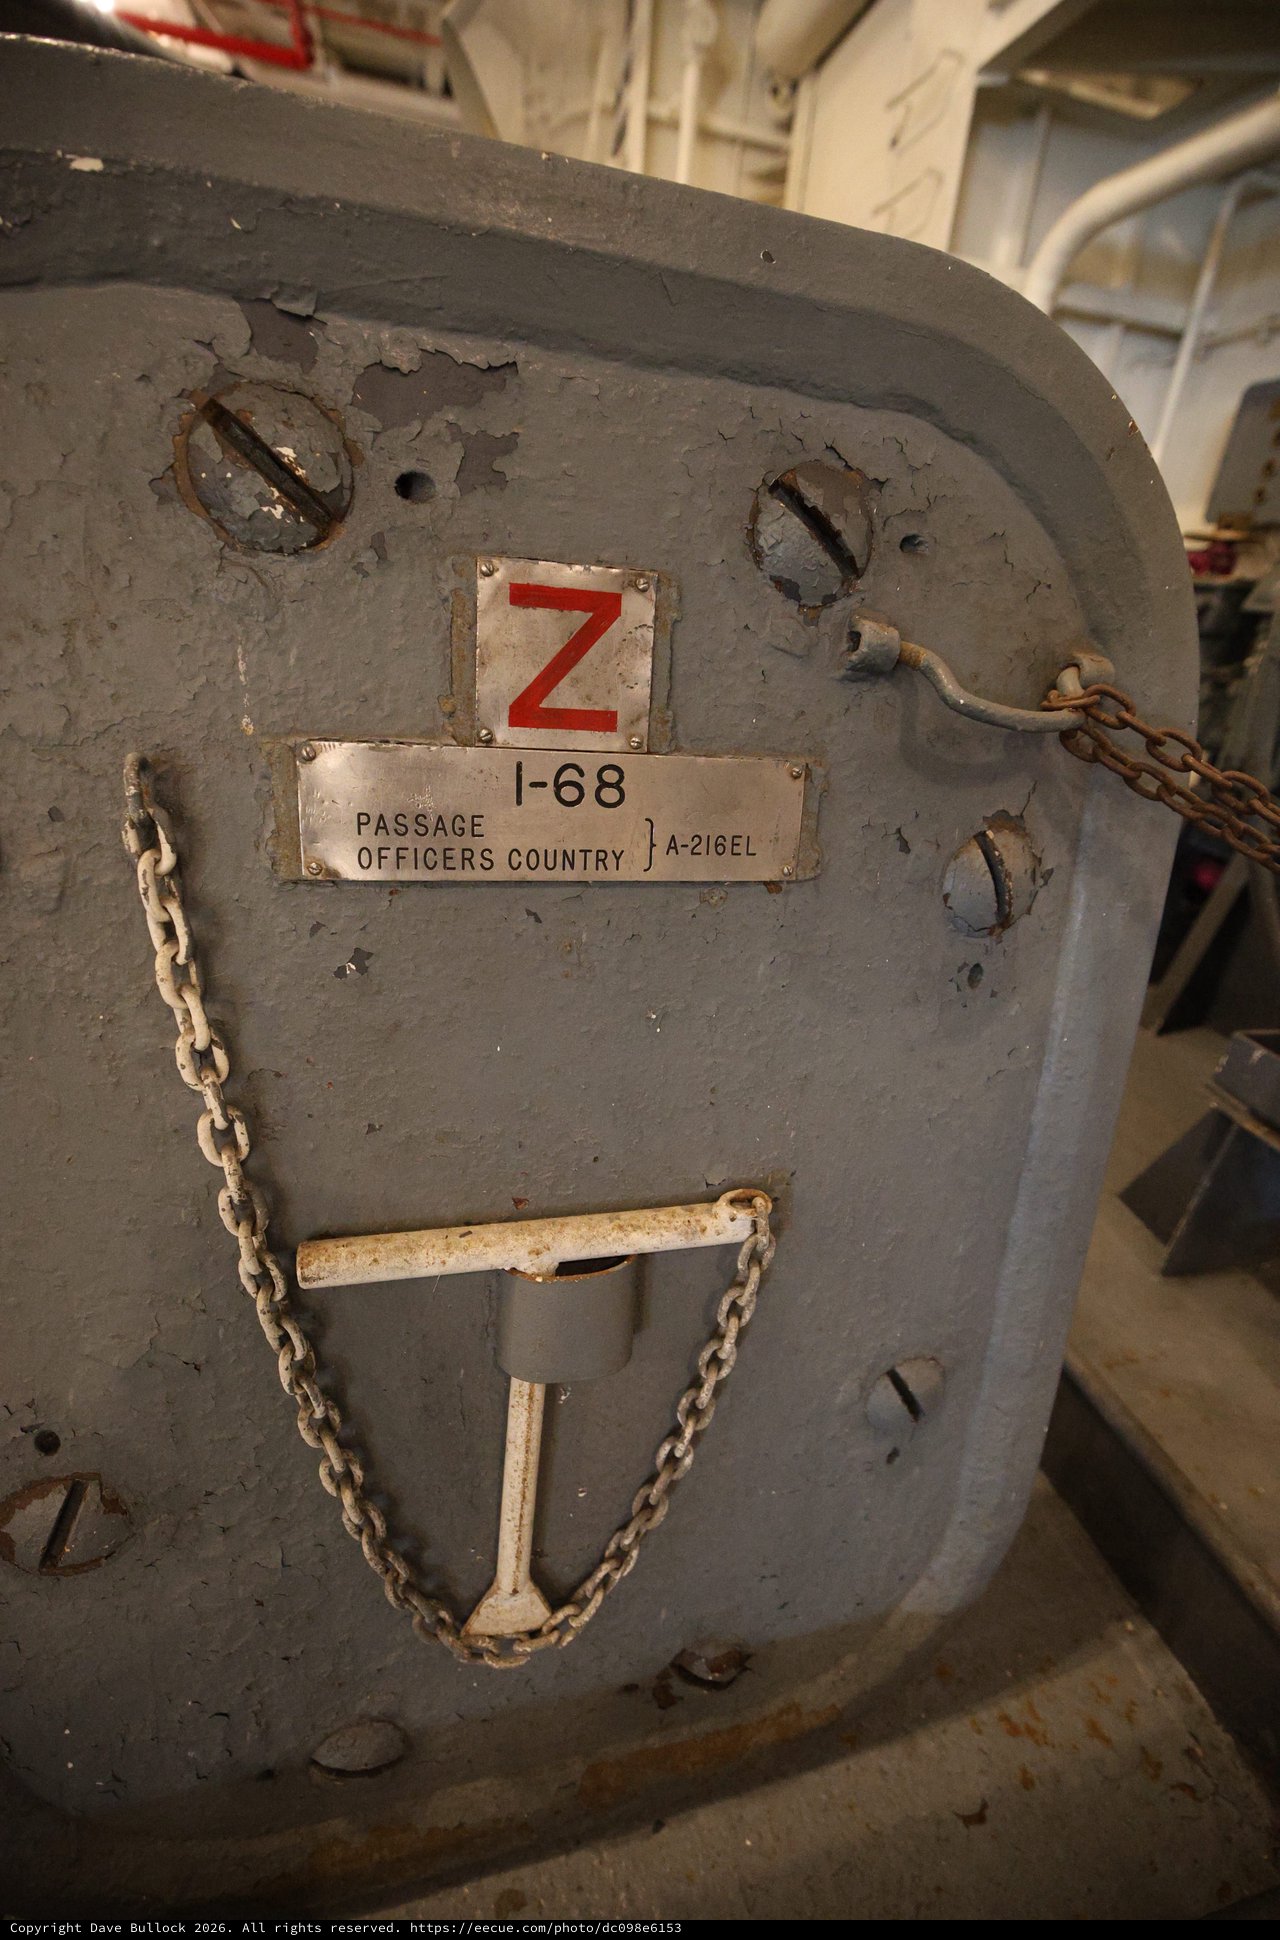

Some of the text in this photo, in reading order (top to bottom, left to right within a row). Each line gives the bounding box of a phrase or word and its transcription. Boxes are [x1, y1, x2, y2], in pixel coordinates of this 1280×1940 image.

[508, 582, 622, 732] Z
[358, 813, 484, 837] PASSAGE
[666, 835, 756, 856] A-216EL
[358, 847, 624, 871] OFFICERS COUNTRY
